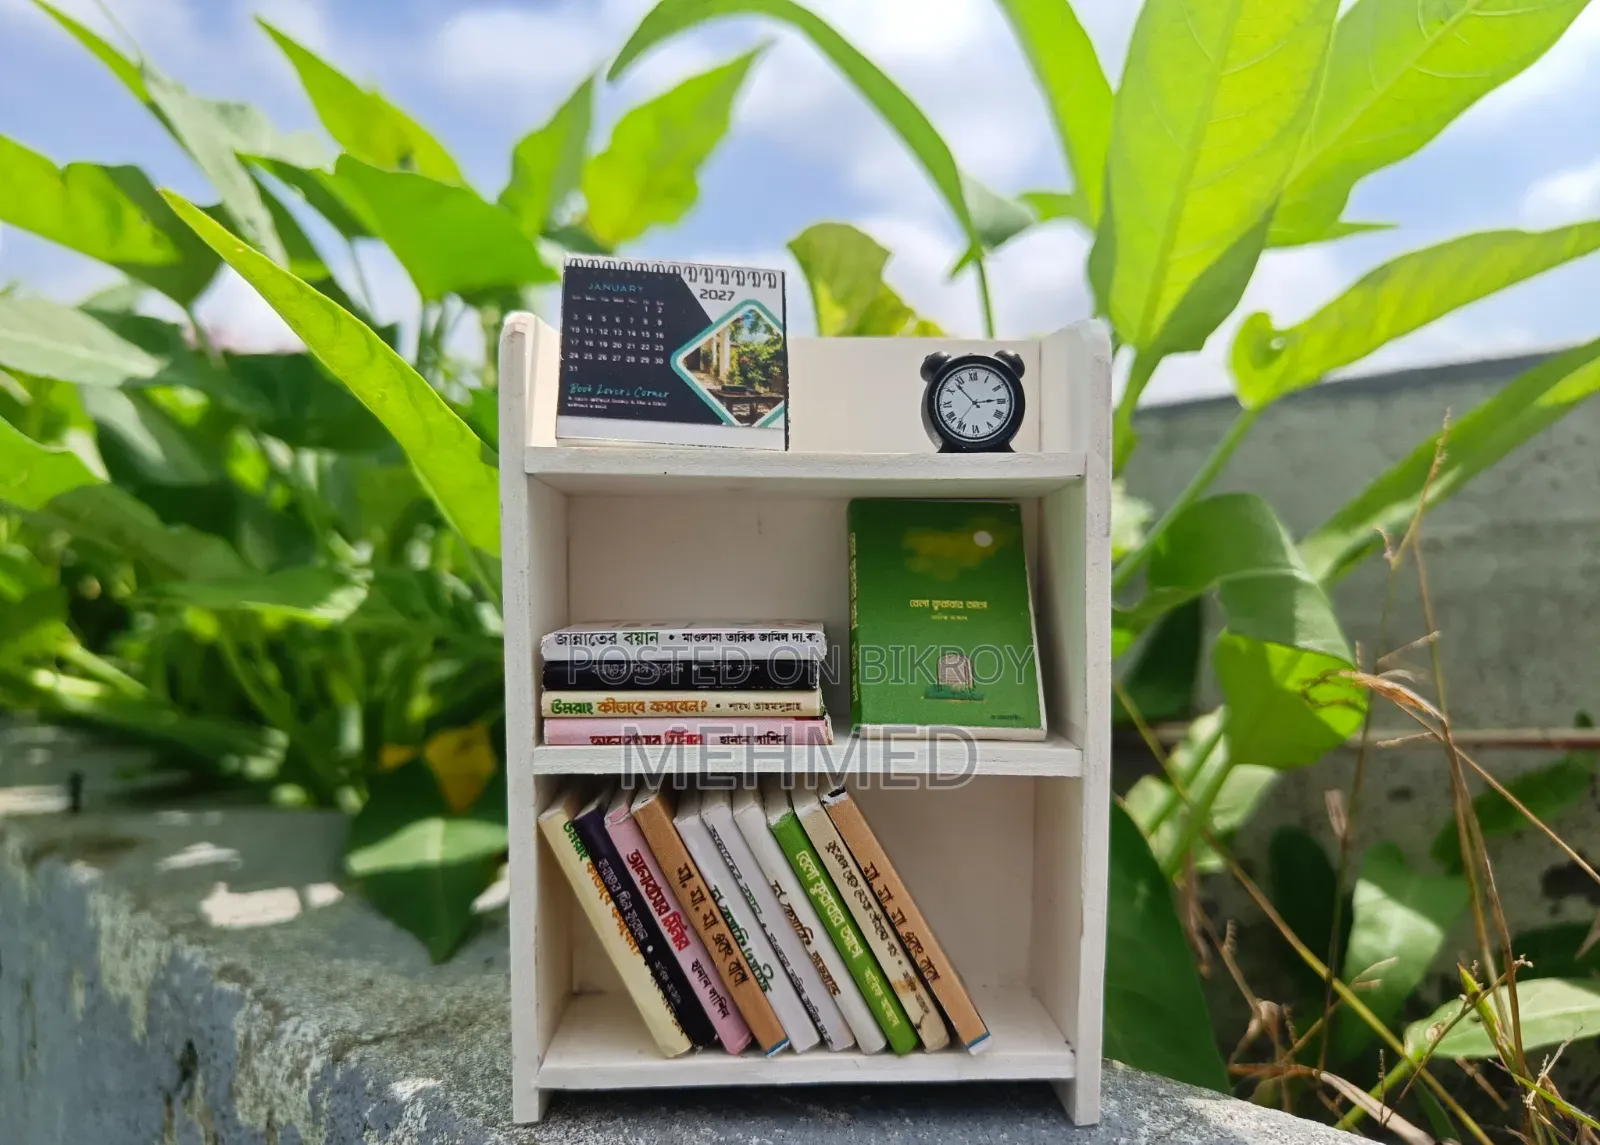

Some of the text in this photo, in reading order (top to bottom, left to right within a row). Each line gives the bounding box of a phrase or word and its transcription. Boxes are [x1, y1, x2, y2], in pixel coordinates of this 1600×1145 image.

[588, 283, 644, 293] JANUARY
[700, 288, 735, 302] 2027
[968, 372, 978, 382] XII
[569, 383, 593, 394] Book
[634, 387, 670, 398] Corner
[553, 632, 617, 646] জান্নাতের
[622, 632, 659, 645] বয়ান
[682, 632, 722, 644] মাওলানা
[725, 631, 755, 644] তারিক
[758, 631, 789, 643] জামিল
[550, 698, 594, 715] উমরাহ
[596, 697, 646, 715] কীভাবে
[649, 700, 708, 714] করবেন?
[796, 850, 818, 879] বেলা
[811, 879, 845, 925] ফুরাবার
[839, 925, 863, 957] আগে
[677, 863, 749, 985] মা. মা. মা এবং বাবা
[692, 959, 711, 987] হানান
